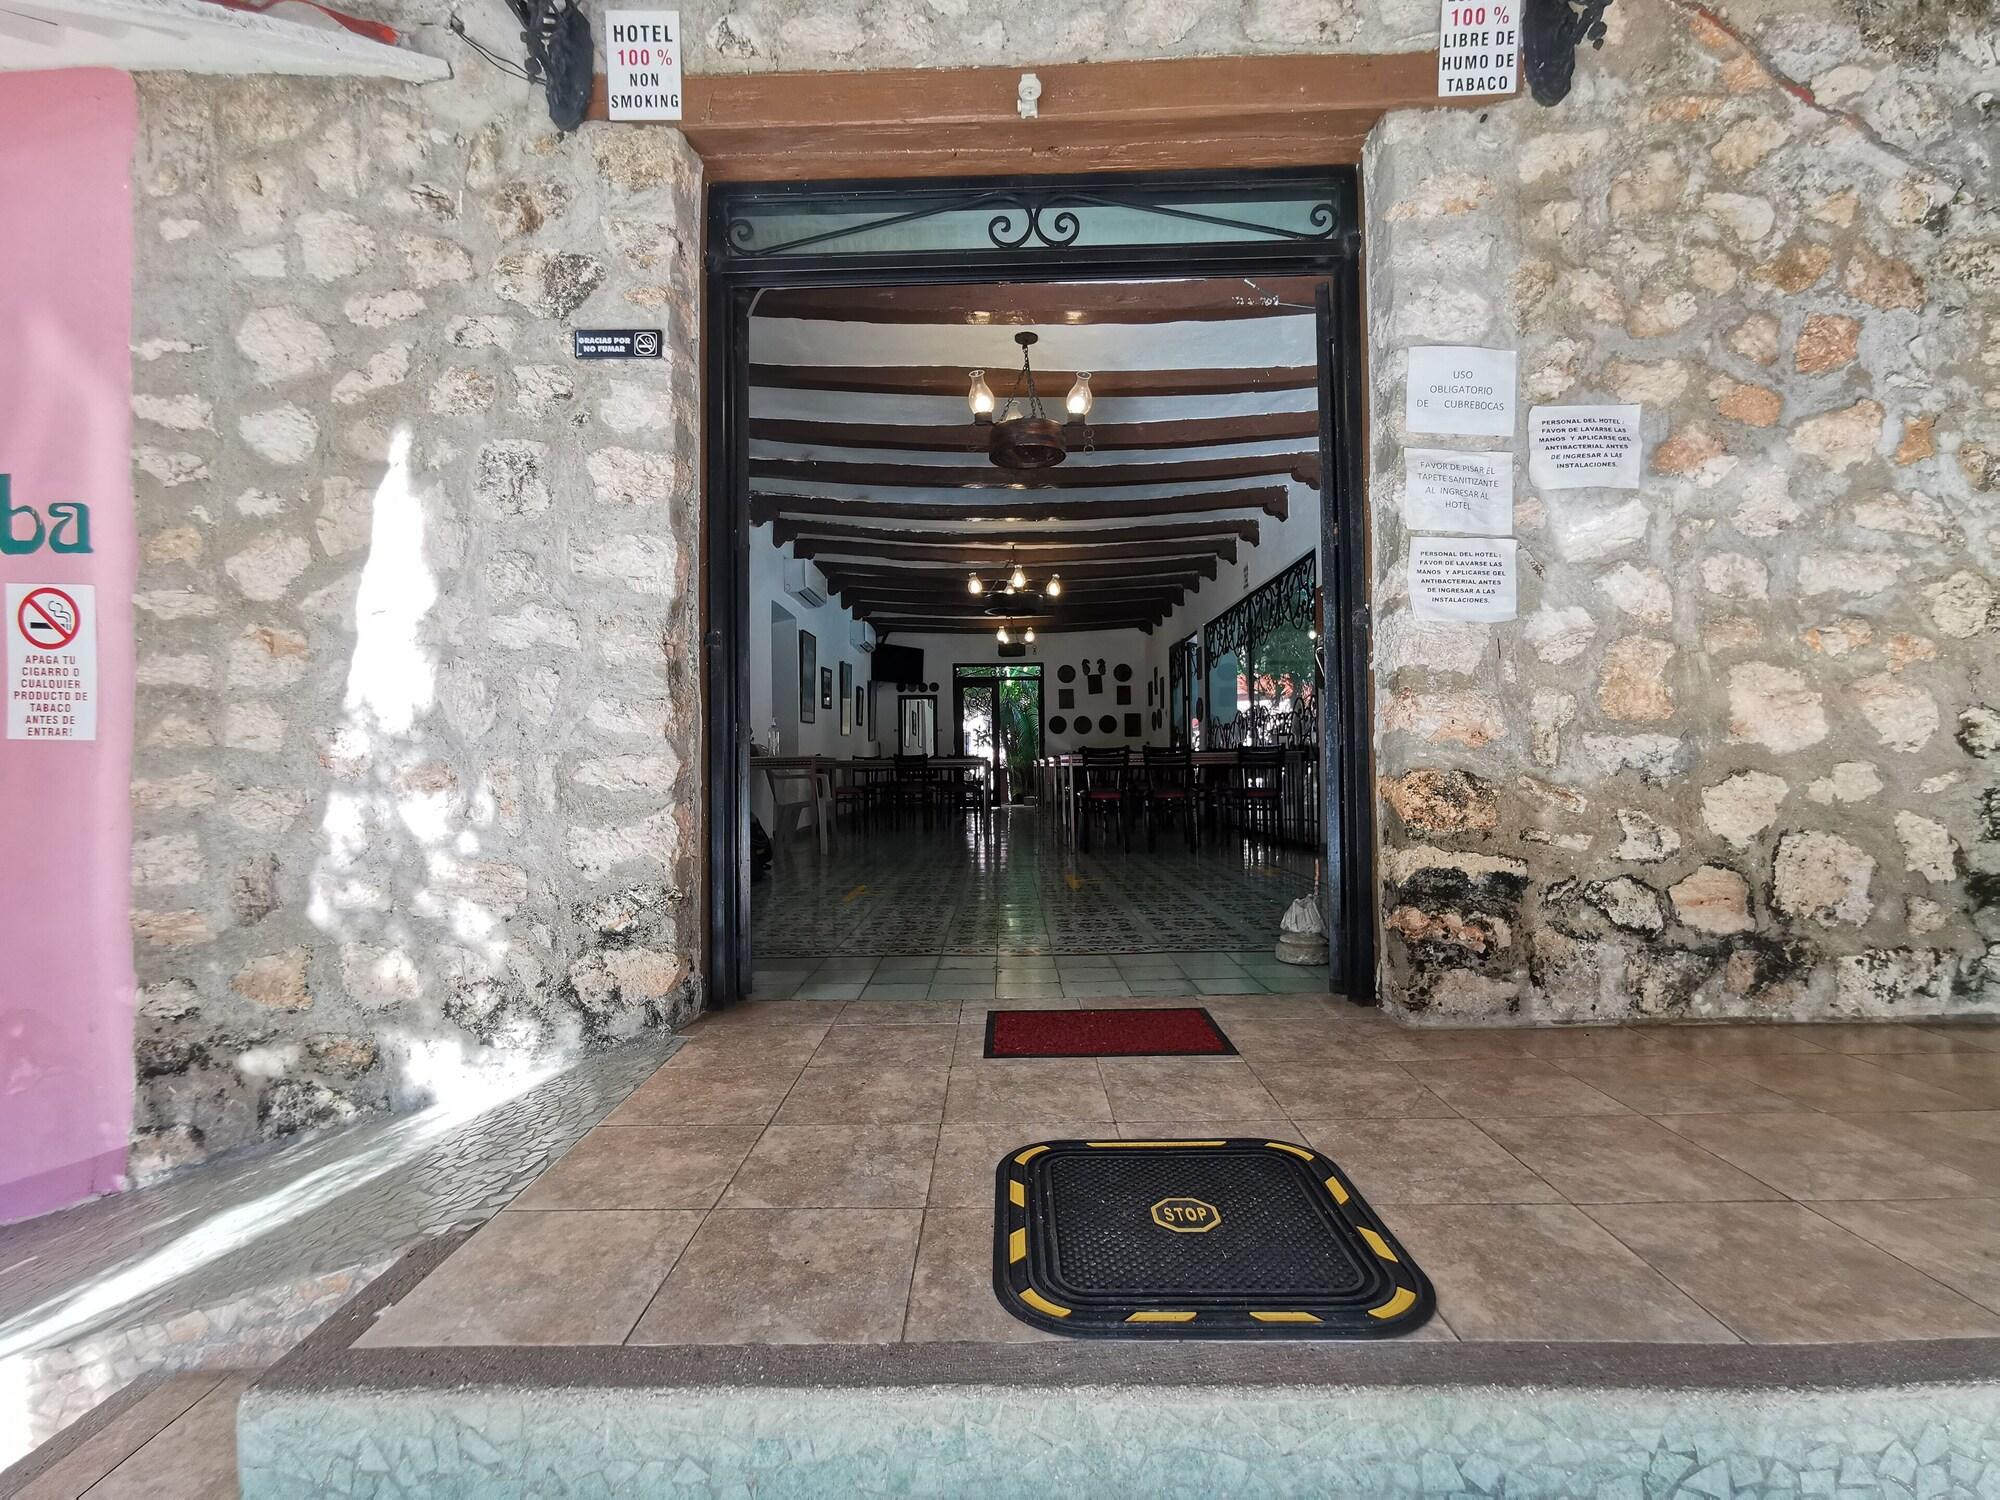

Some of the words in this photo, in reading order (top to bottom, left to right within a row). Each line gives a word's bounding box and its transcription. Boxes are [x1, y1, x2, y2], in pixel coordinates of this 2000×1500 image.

[613, 25, 673, 42] HOTEL
[1444, 32, 1489, 48] LIBRE
[1496, 30, 1515, 45] DE
[1442, 54, 1488, 71] HUMO
[1495, 53, 1514, 68] DE
[630, 73, 659, 87] NON
[1446, 76, 1508, 92] TABACO
[611, 94, 679, 108] SMOKING
[1453, 370, 1473, 379] USO
[1430, 385, 1493, 395] OBLIGATORIO
[1416, 400, 1429, 408] DE
[1444, 400, 1504, 411] CUBREBOCAS
[1420, 461, 1448, 470] FAVOR
[1462, 465, 1484, 474] PISAR
[1417, 473, 1447, 482] TAPETE
[1448, 476, 1499, 487] SANITIZANTE
[1425, 486, 1435, 494] AL
[1440, 487, 1479, 498] INGRESAR
[1480, 492, 1489, 500] AL
[1445, 501, 1471, 510] HOTEL
[25, 655, 59, 664] APAGA
[62, 656, 76, 664] TU
[22, 667, 69, 676] CIGARRO
[73, 668, 79, 677] O
[21, 679, 81, 689] CUALQUIER
[14, 691, 71, 701] PRODUCTO
[75, 692, 88, 701] DE
[30, 703, 71, 713] TABACO
[25, 715, 58, 724] ANTES
[62, 716, 76, 724] DE
[1163, 1207, 1207, 1222] STOP
